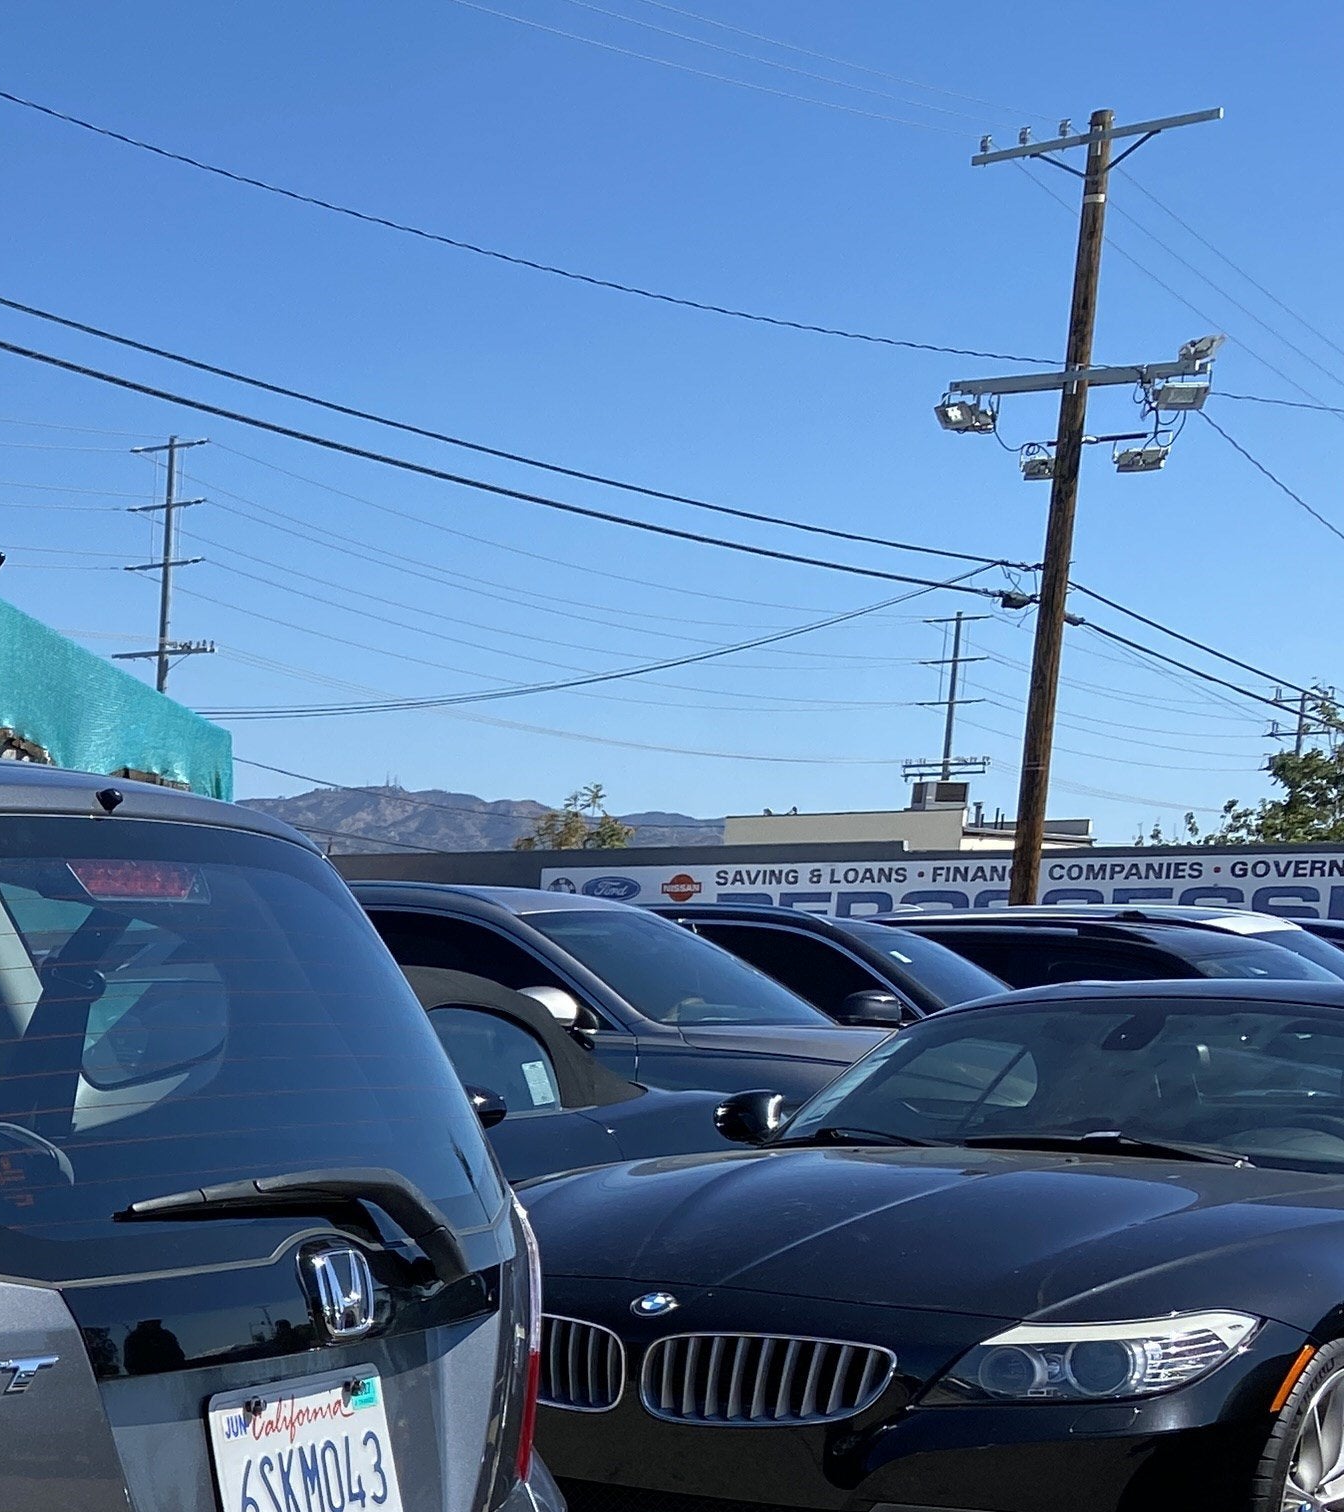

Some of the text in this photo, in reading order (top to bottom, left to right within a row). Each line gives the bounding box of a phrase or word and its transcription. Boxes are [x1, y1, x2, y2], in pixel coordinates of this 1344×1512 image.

[715, 868, 799, 886] SAVING
[808, 868, 822, 885] &
[829, 867, 908, 885] LOANS
[931, 865, 1014, 884] FINAN
[1048, 862, 1204, 881] COMPANIES
[593, 880, 629, 897] Ford
[662, 881, 702, 895] NISSAN
[225, 1414, 250, 1440] JUN
[251, 1394, 355, 1444] California
